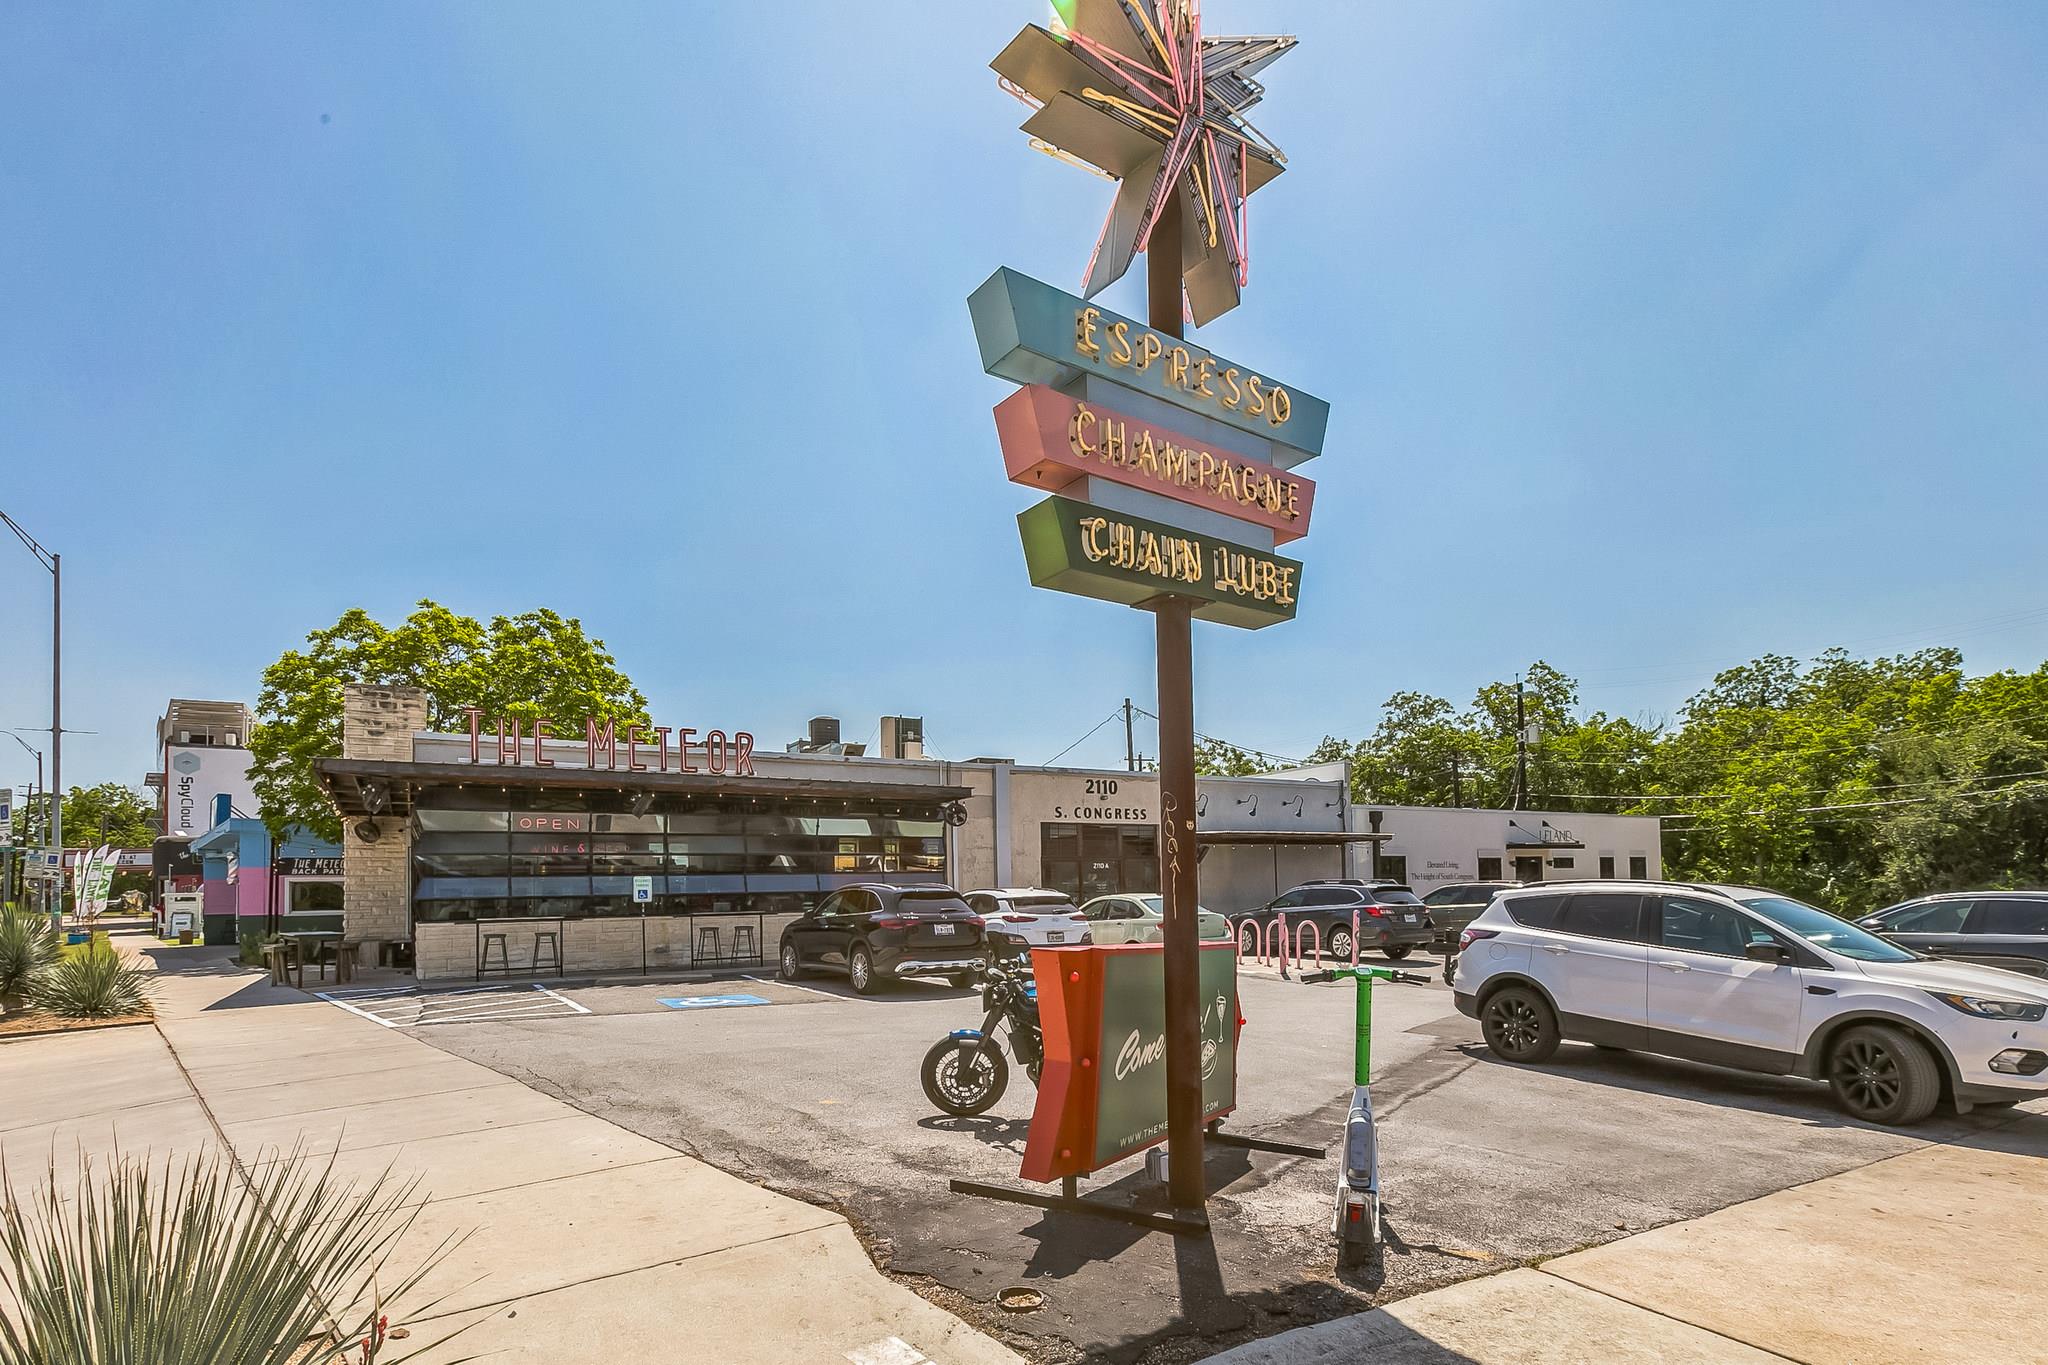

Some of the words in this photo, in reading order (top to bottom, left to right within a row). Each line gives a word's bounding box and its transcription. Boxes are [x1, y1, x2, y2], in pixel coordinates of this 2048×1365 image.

[1075, 307, 1291, 426] ESPRESSO
[1068, 402, 1299, 521] CHAMPAGNE
[1080, 517, 1202, 583] CHAIN
[1214, 547, 1295, 606] LUBE
[462, 708, 554, 766] THE
[587, 717, 756, 776] METEOR
[178, 777, 194, 828] SpyCloud
[1085, 779, 1118, 795] 2110
[519, 818, 580, 829] OPEN
[1054, 806, 1067, 818] S.
[1074, 807, 1147, 820] CONGRESS
[294, 858, 311, 868] THE
[315, 858, 345, 869] METEO
[1115, 1029, 1165, 1080] Come
